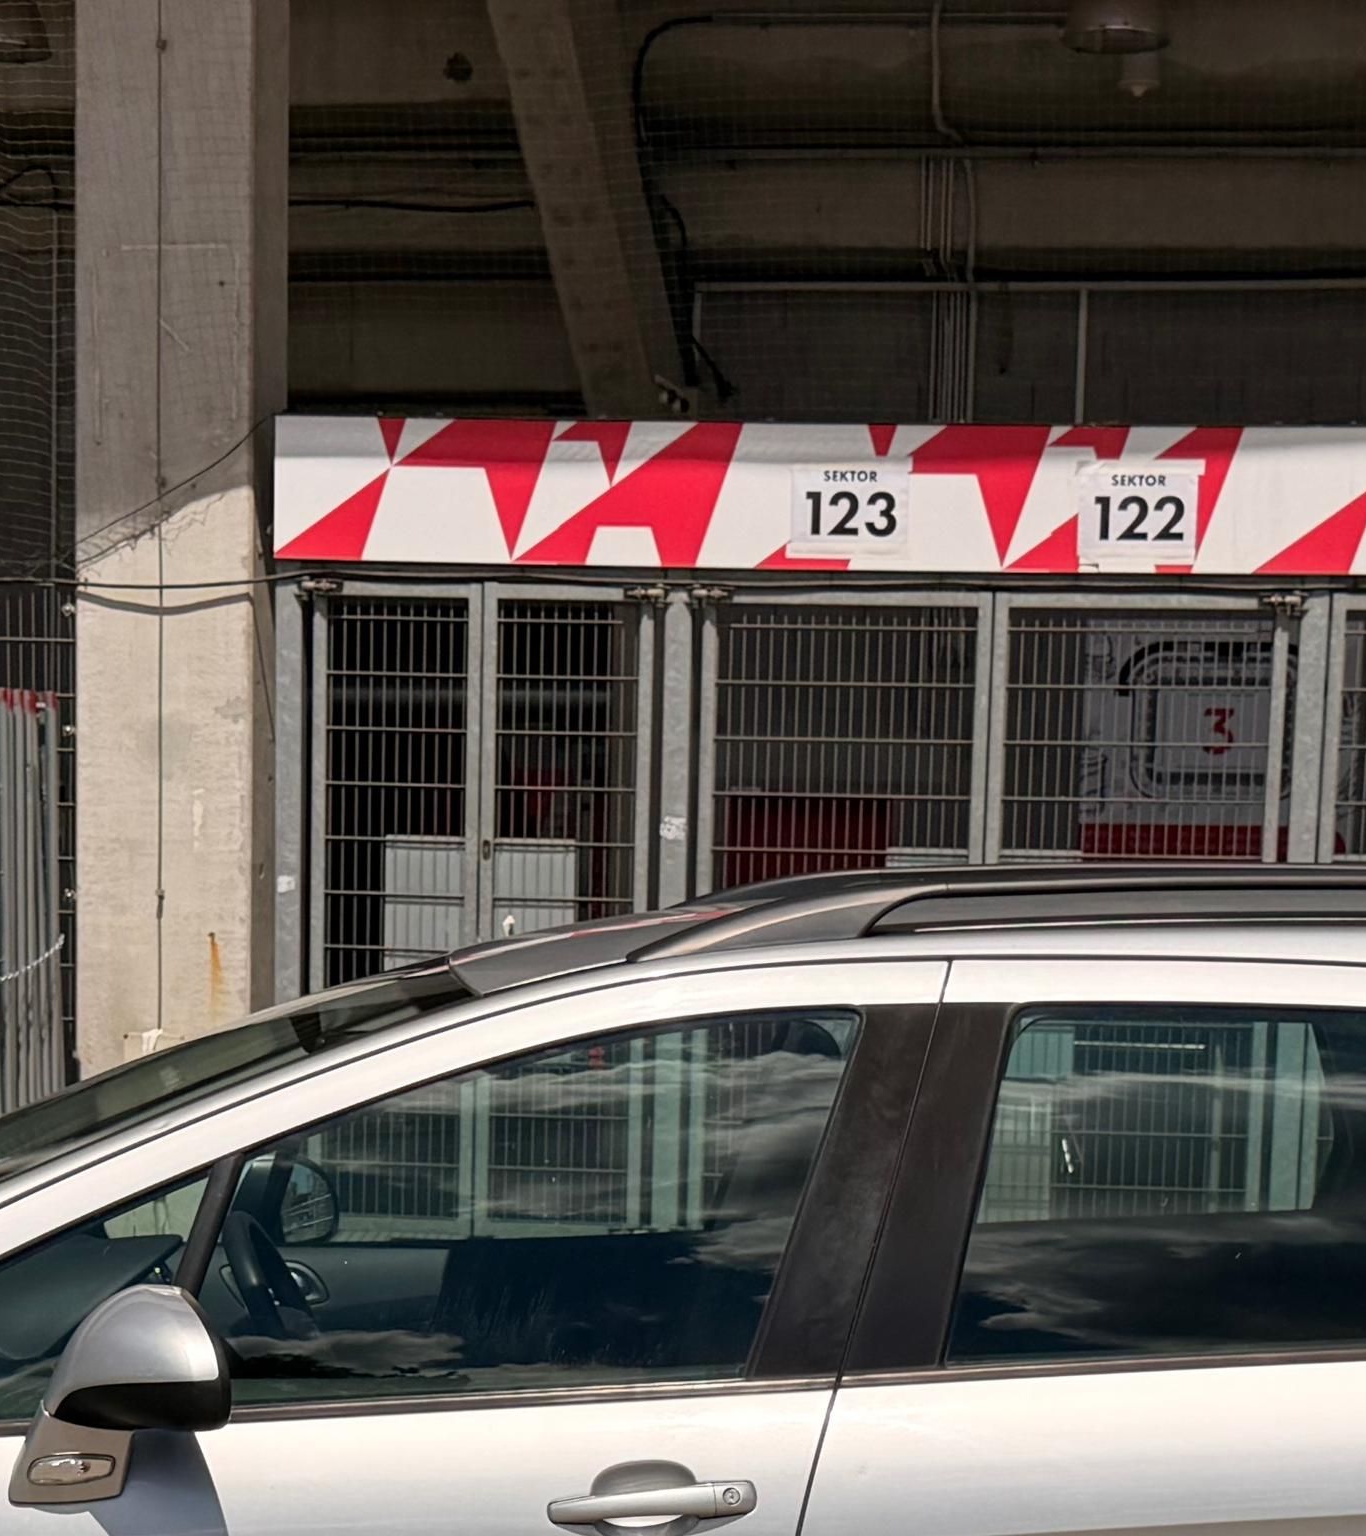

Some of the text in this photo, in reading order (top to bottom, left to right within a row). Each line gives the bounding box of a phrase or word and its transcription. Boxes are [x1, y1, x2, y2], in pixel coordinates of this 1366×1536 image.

[823, 470, 878, 482] SEKTOR
[1111, 474, 1166, 486] SEKTOR
[805, 491, 897, 537] 123
[1094, 496, 1185, 541] 122
[1202, 706, 1235, 755] 3
